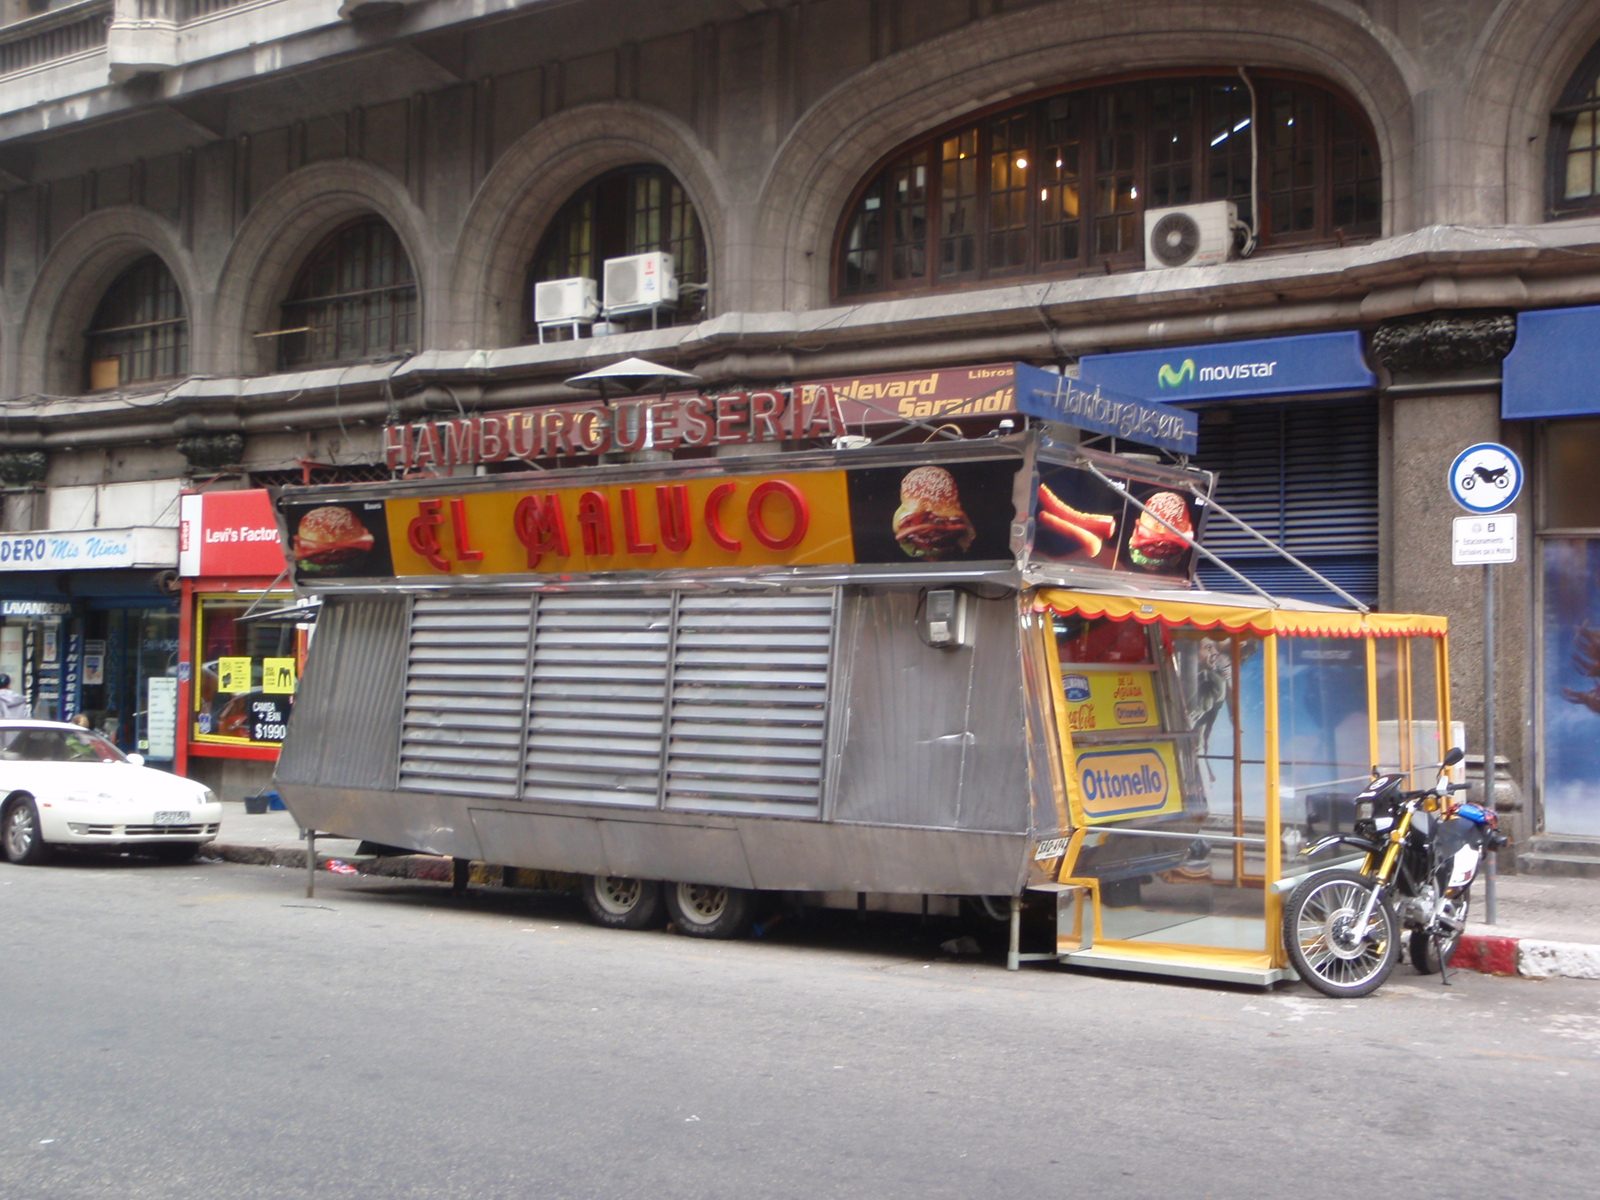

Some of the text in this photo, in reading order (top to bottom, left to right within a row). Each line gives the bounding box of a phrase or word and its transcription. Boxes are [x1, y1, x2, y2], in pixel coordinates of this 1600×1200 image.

[968, 368, 1015, 380] Libros
[1199, 361, 1278, 382] movistar
[800, 373, 939, 405] Bulevard
[384, 383, 848, 471] HAMBURGUESERIA
[205, 527, 239, 543] Levi's
[407, 479, 811, 572] EL MALUCO
[3, 601, 71, 615] LAVANDERIA
[255, 723, 286, 739] $1990
[1082, 764, 1162, 801] Ottonello
